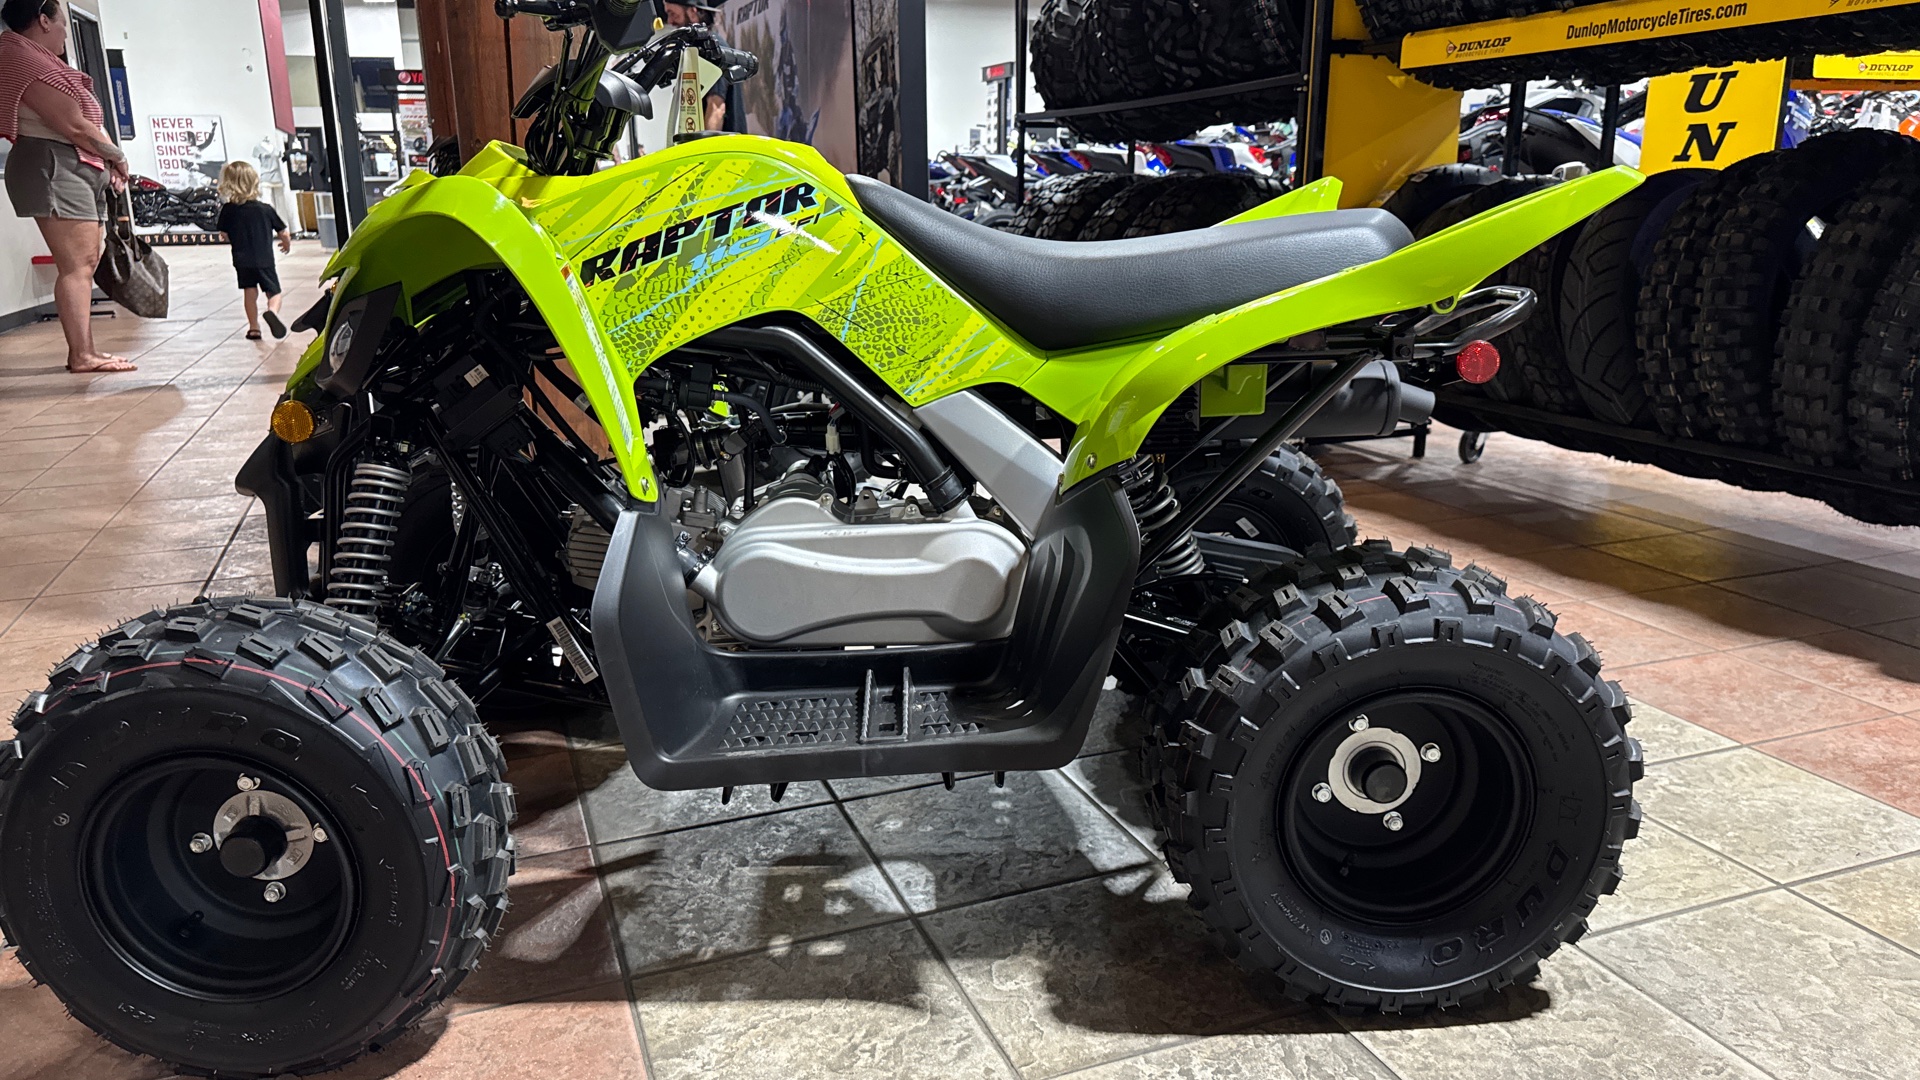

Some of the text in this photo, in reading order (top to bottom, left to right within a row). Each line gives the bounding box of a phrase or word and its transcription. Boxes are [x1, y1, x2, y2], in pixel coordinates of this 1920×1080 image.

[1566, 2, 1748, 40] DunlopMotorcycleTires.com
[1457, 36, 1512, 52] DUNLOP
[1869, 64, 1913, 72] DUNLOP
[152, 118, 194, 129] NEVER
[154, 131, 216, 143] FINISED.
[156, 145, 194, 156] SINCE
[143, 232, 226, 244] OTORCYCLE
[579, 182, 820, 288] RAPTOR
[688, 228, 775, 271] 110
[1430, 842, 1571, 968] DURO
